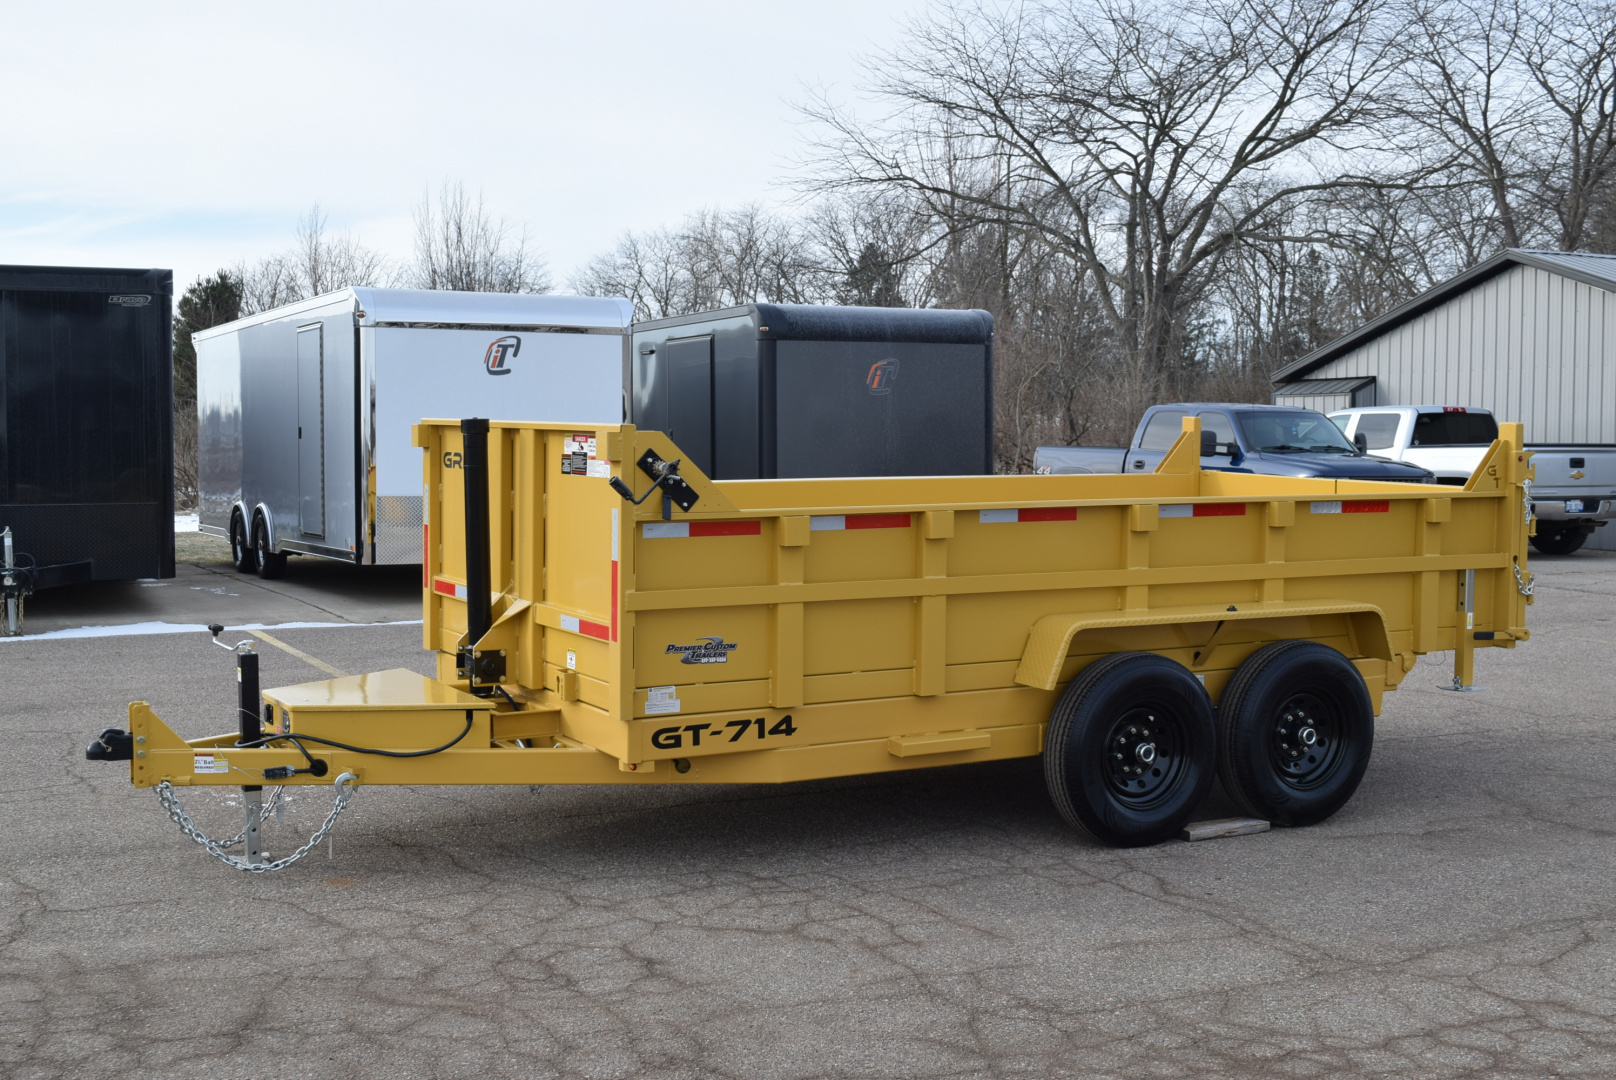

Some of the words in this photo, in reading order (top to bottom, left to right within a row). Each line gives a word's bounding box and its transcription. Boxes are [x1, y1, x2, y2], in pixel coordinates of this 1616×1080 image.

[443, 451, 464, 469] GR
[665, 643, 703, 653] PREMIER
[704, 642, 737, 651] CUSTOM
[690, 651, 727, 659] TRAILERS
[651, 715, 798, 749] GT-714
